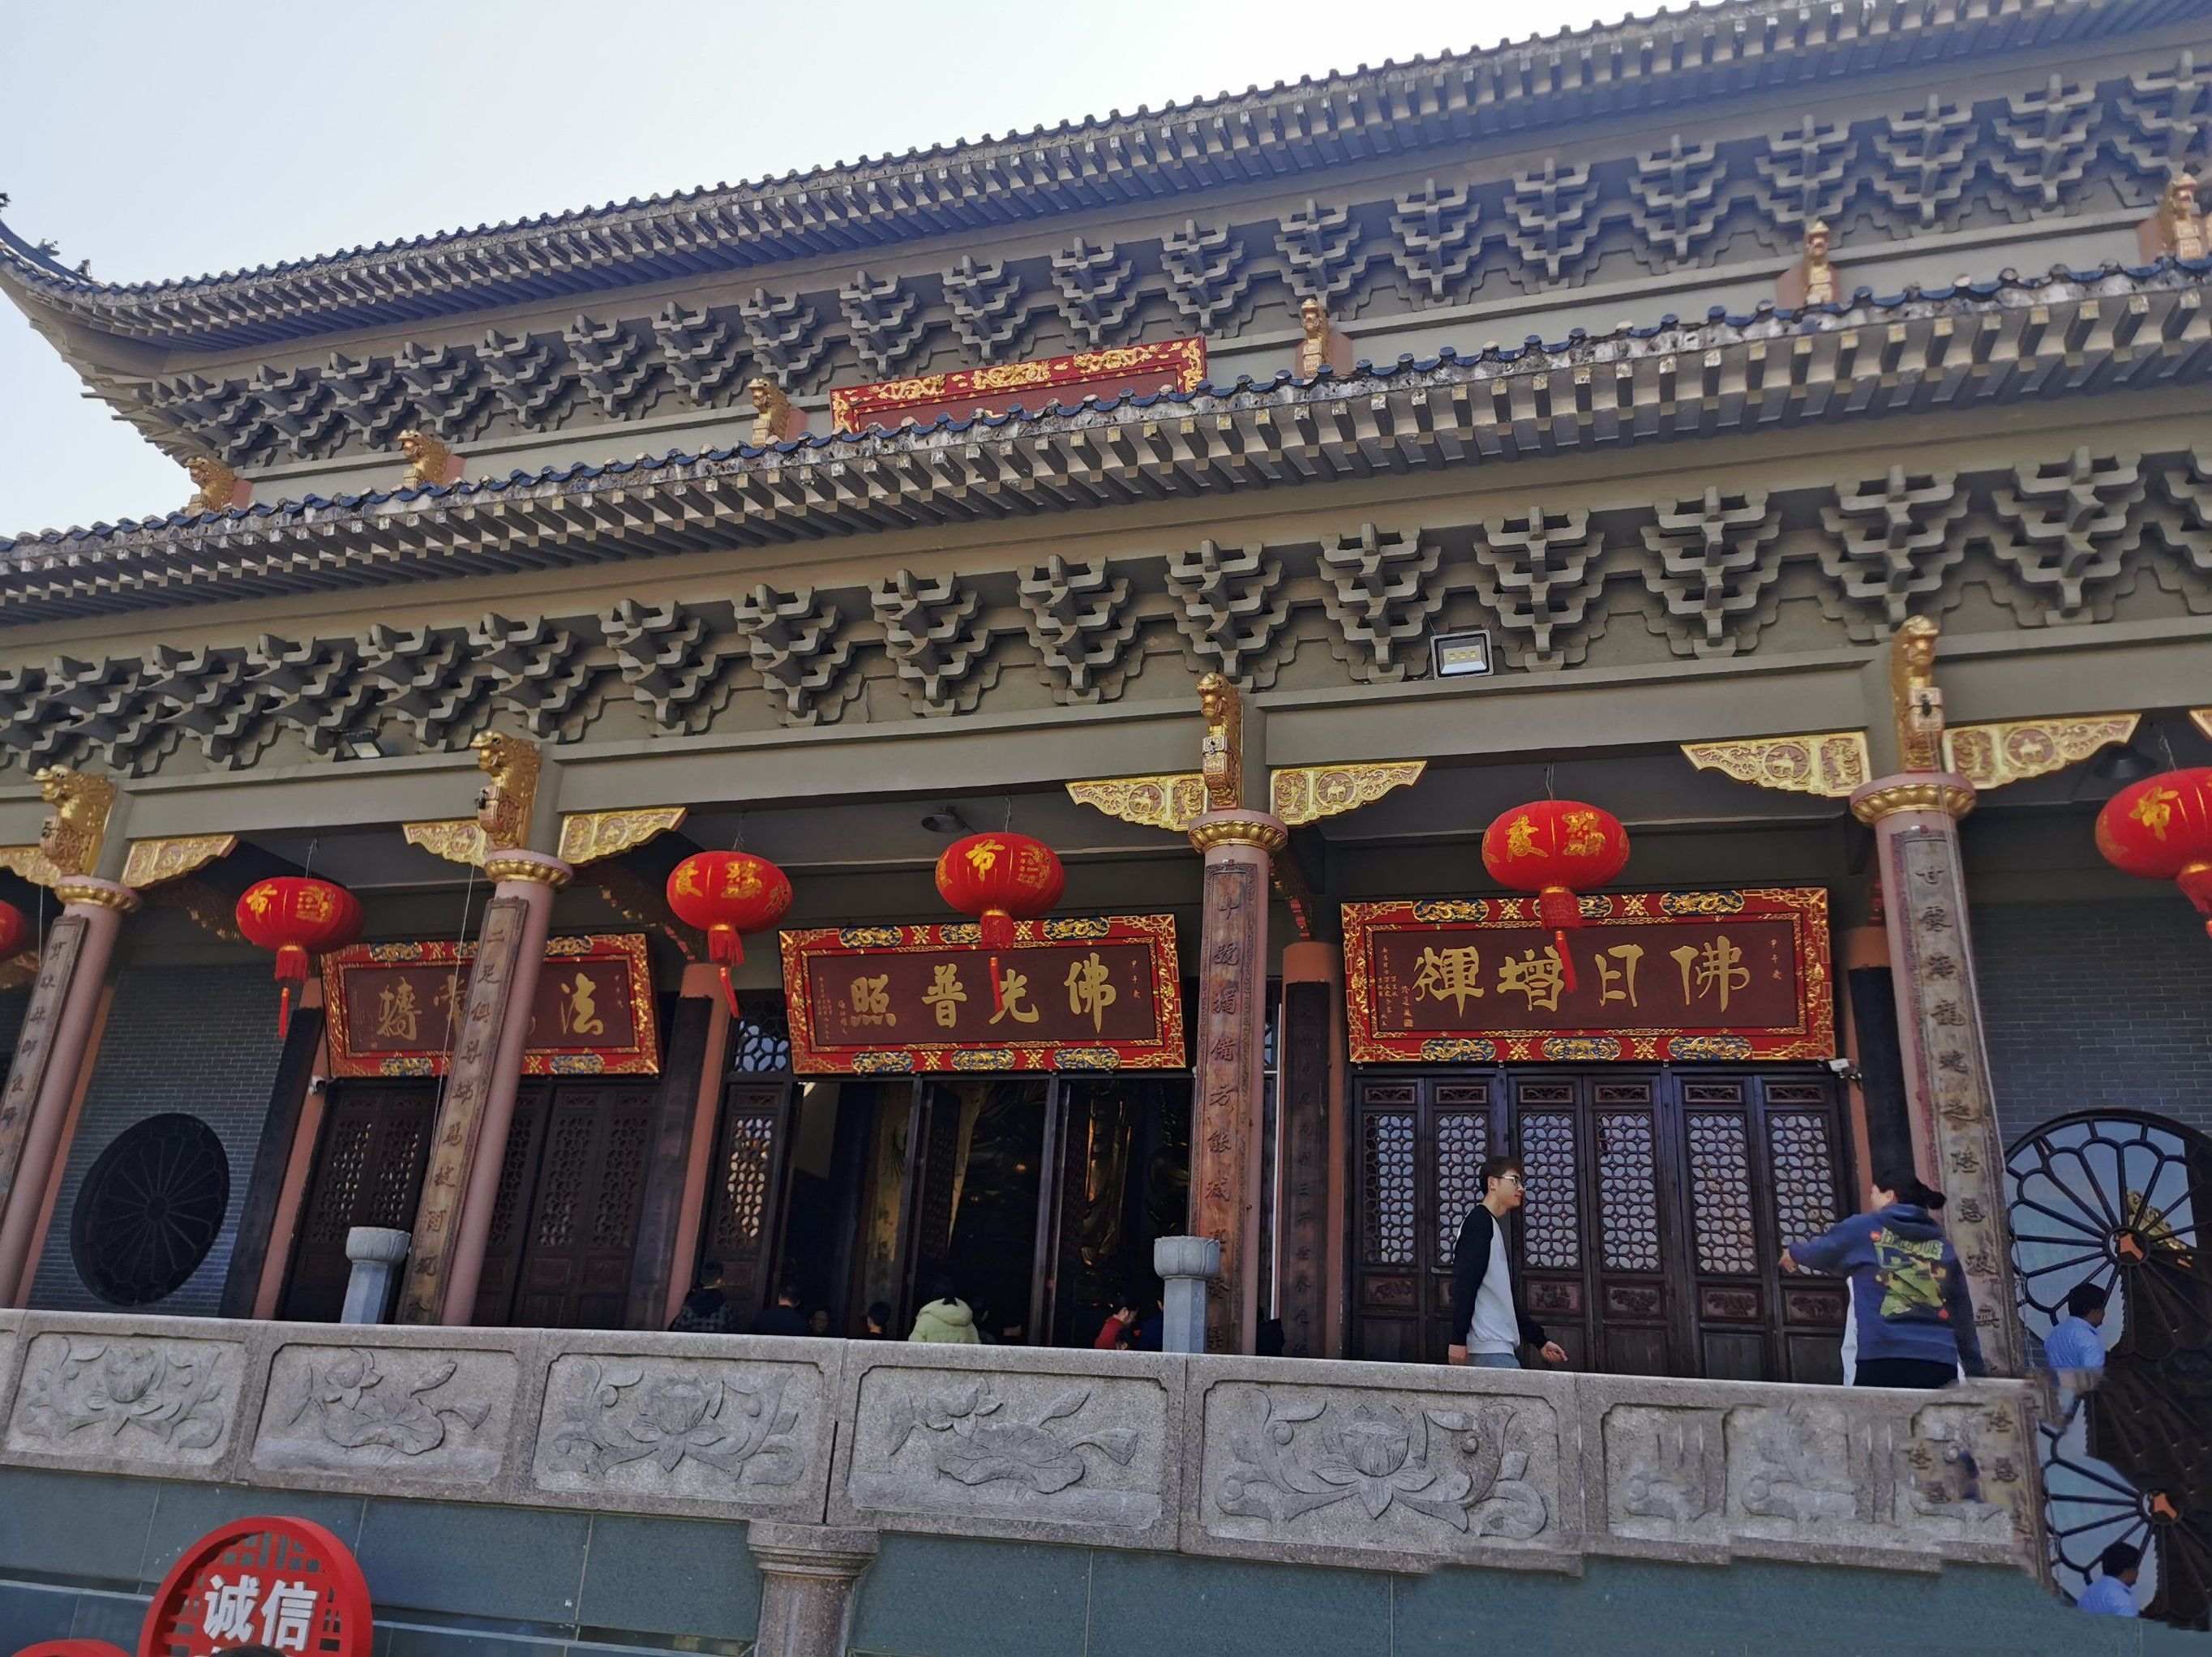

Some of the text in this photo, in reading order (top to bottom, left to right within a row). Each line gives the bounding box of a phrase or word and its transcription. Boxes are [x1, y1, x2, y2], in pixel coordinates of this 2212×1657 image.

[850, 952, 1117, 1034] 佛光普照
[203, 1574, 319, 1652] 诚信
